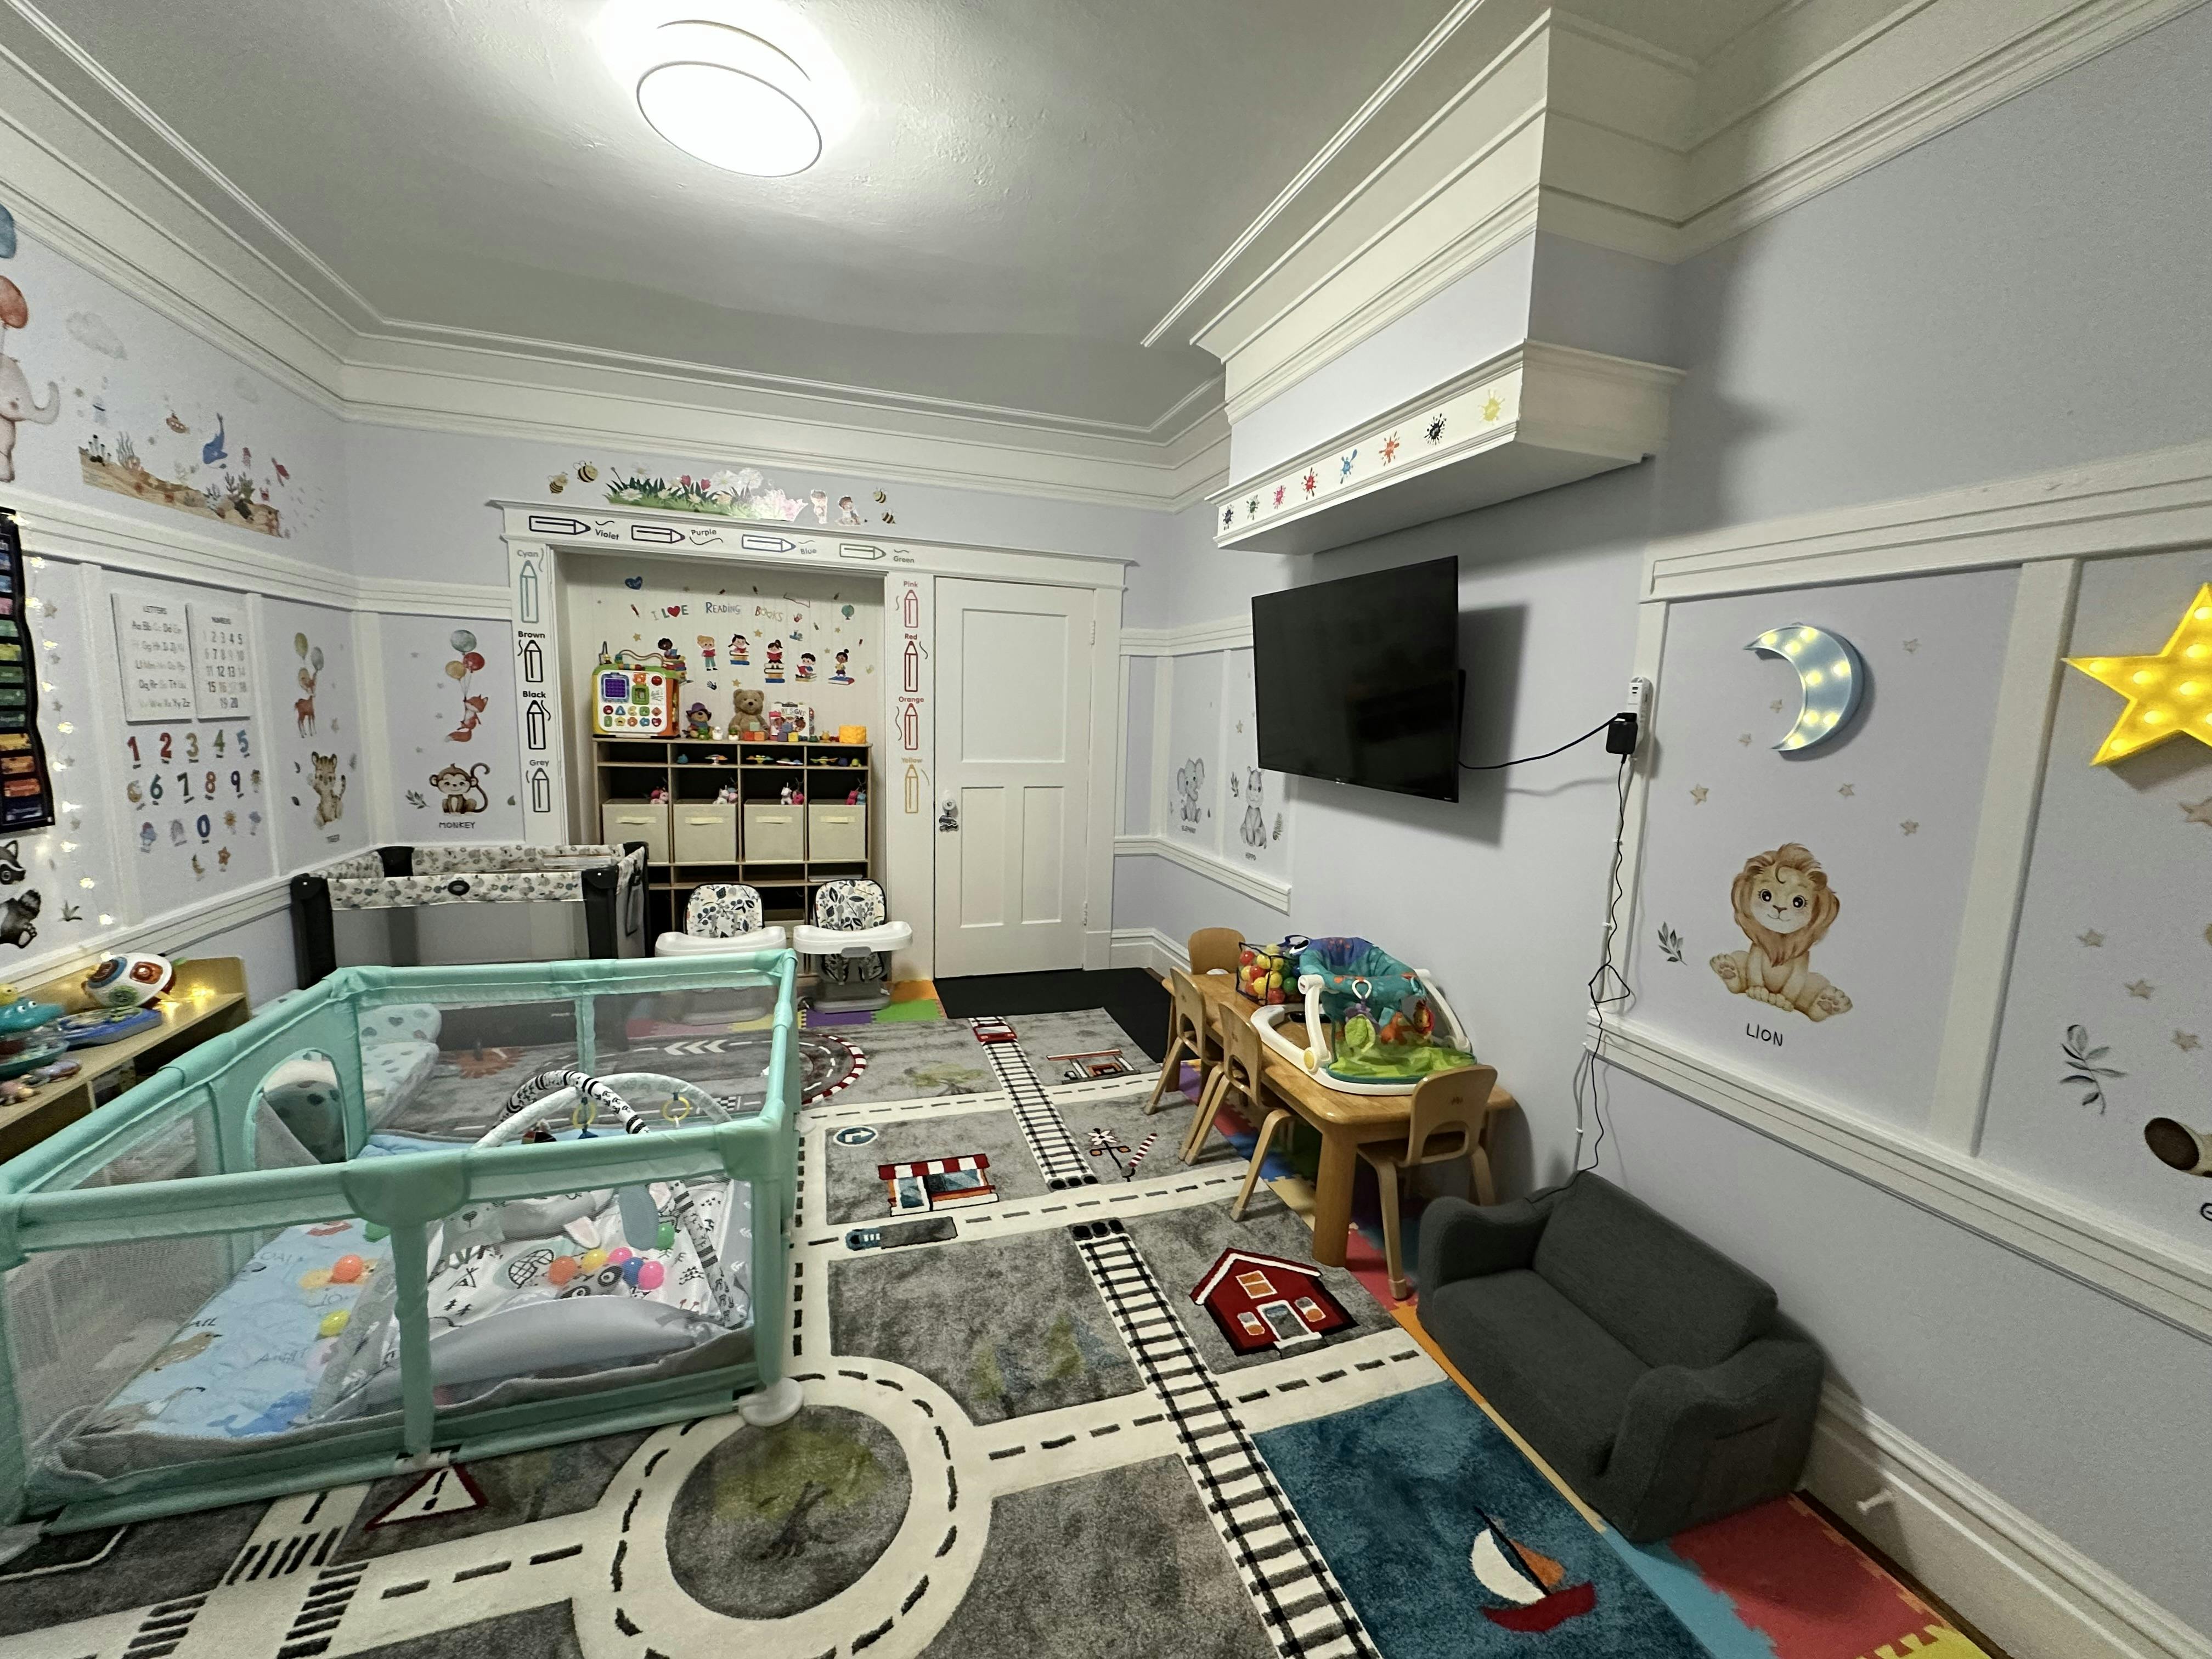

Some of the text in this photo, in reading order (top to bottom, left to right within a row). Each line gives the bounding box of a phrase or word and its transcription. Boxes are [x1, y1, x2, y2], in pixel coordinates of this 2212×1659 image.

[595, 528, 619, 540] Violet
[517, 549, 539, 558] Cyan
[518, 630, 546, 639] Brown
[522, 690, 547, 698] Black
[898, 696, 924, 704] Orange
[127, 729, 249, 761] 1 2 3 4 5
[529, 759, 550, 768] Grey
[150, 770, 241, 800] 6 7 8 9
[439, 821, 476, 830] MONKEY
[1746, 1023, 1783, 1047] LION
